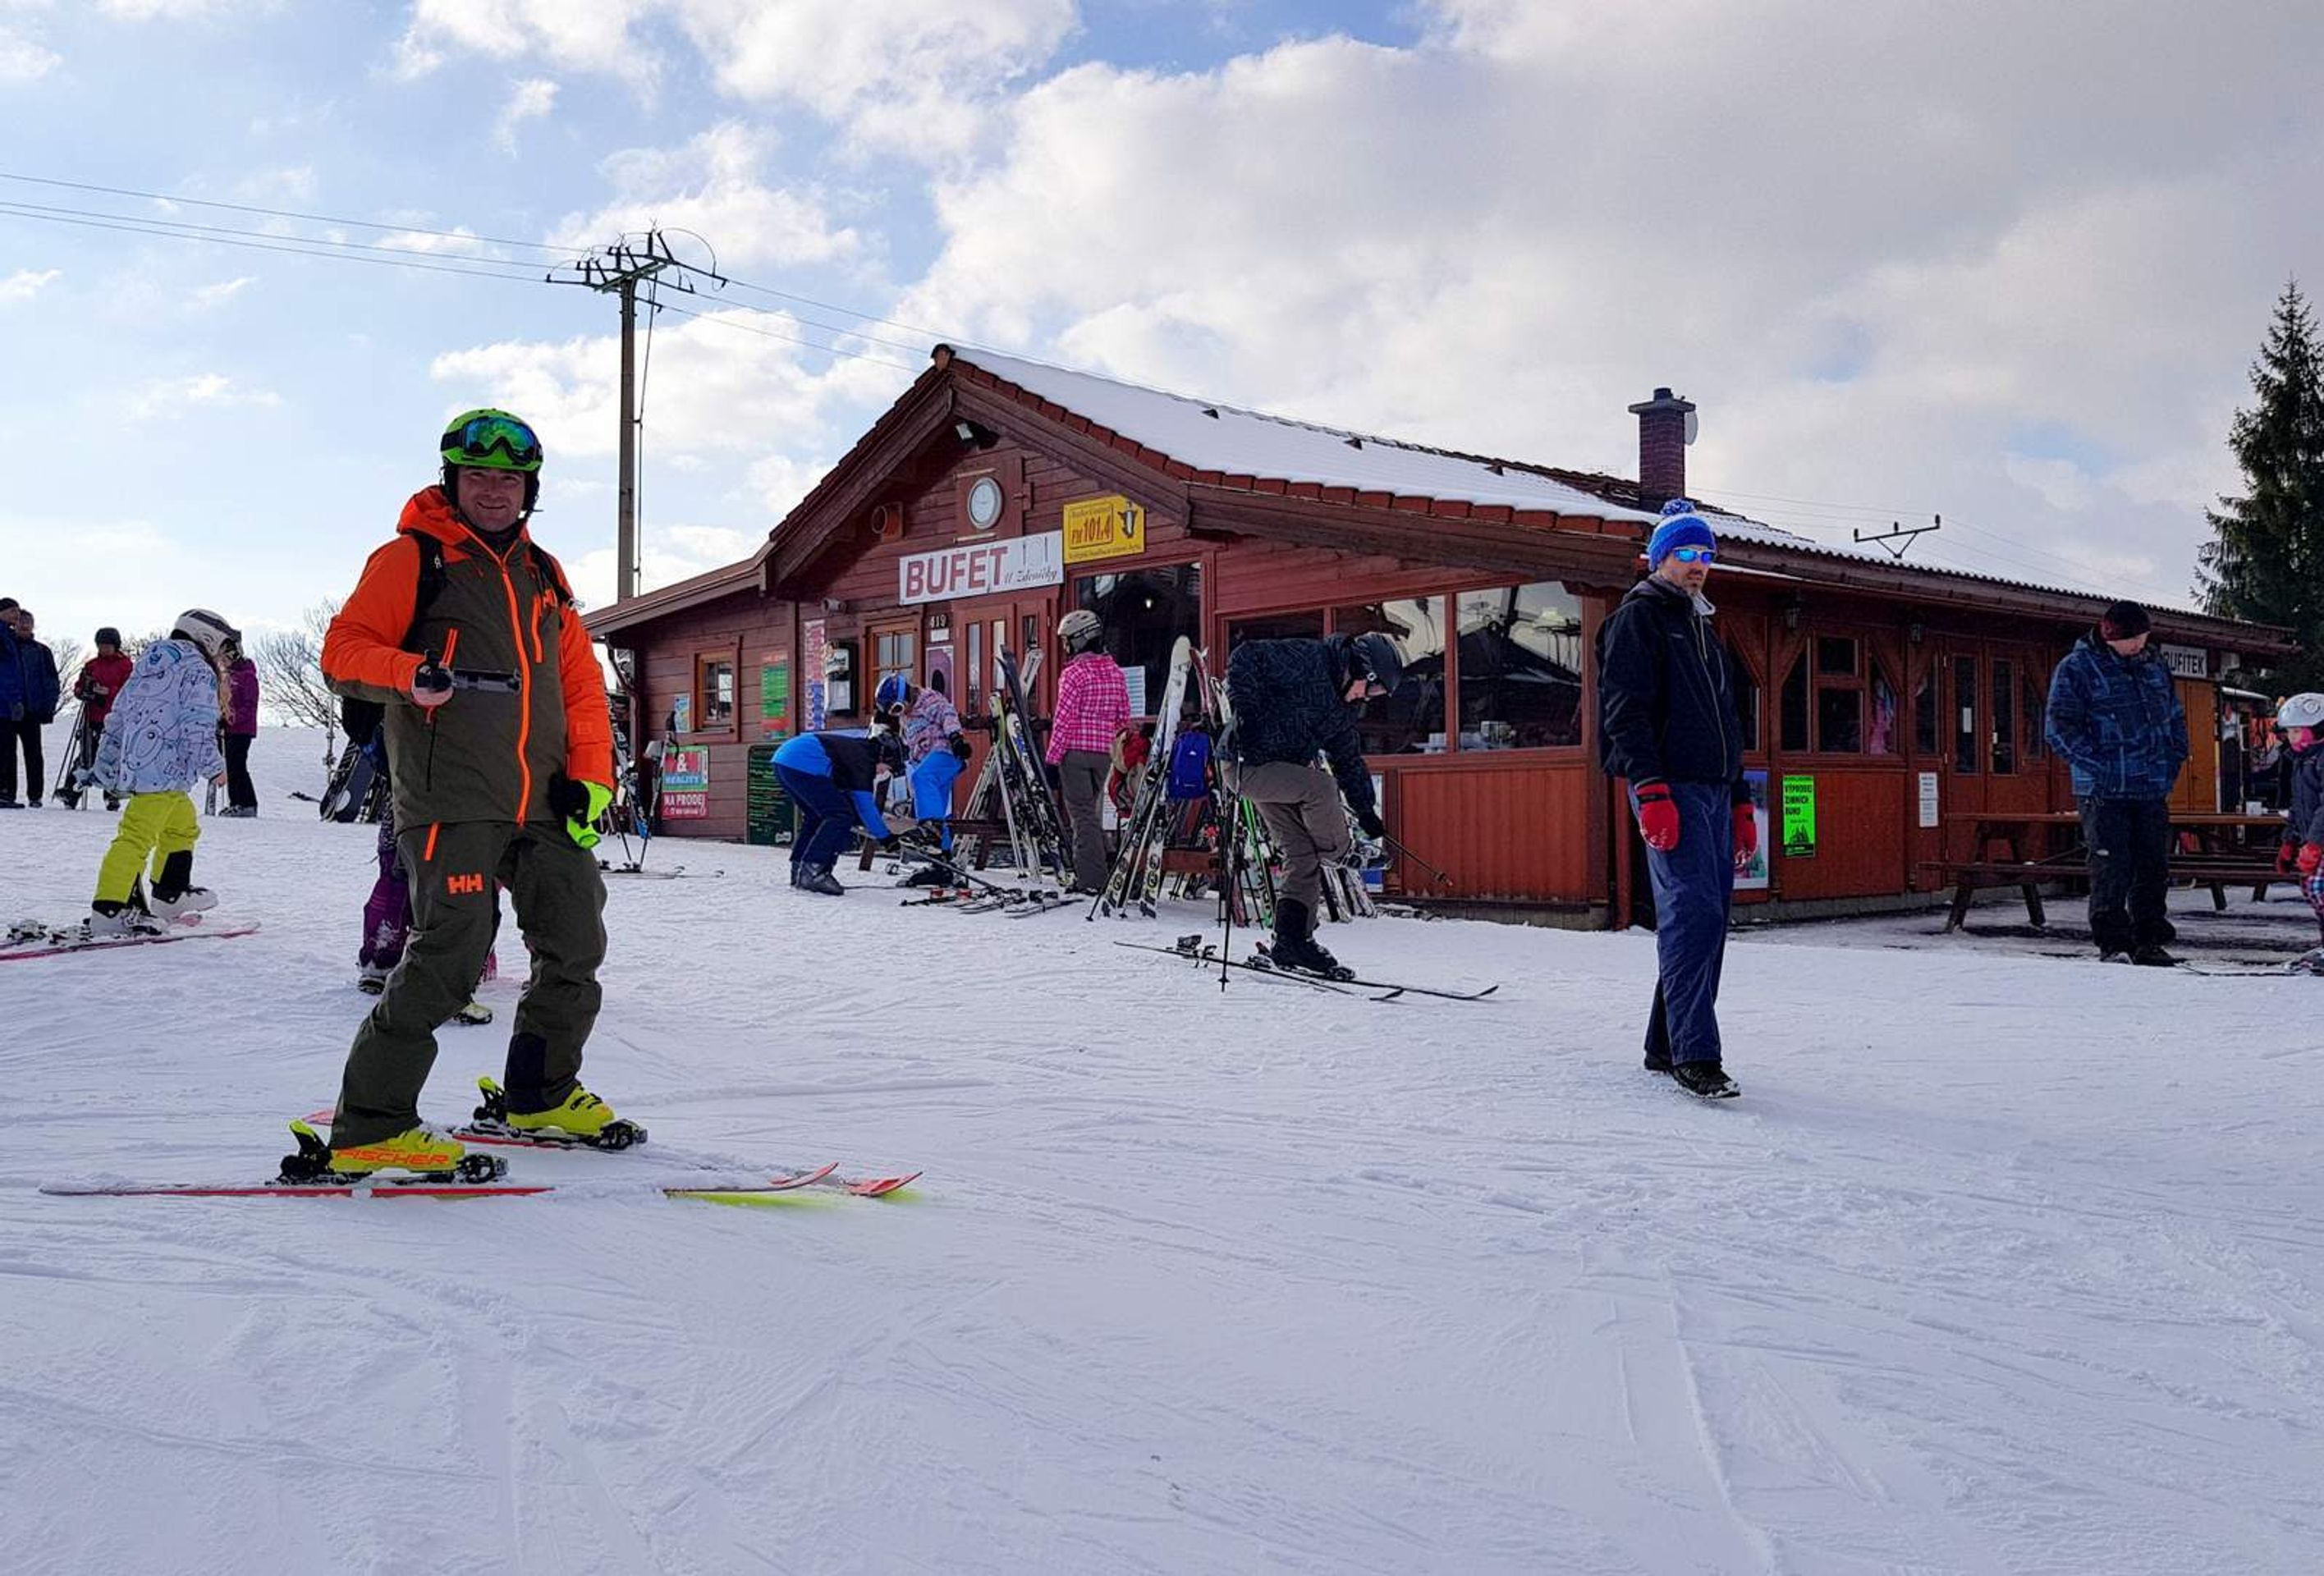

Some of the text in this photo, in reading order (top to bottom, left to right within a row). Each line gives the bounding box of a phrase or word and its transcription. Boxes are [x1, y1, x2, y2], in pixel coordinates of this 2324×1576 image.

[1084, 515, 1111, 543] 101.4
[905, 546, 1011, 598] BUFET
[929, 614, 947, 629] 419
[677, 754, 687, 772] &
[664, 794, 675, 806] NA
[447, 873, 483, 895] HH
[336, 1149, 450, 1165] FISCHER
